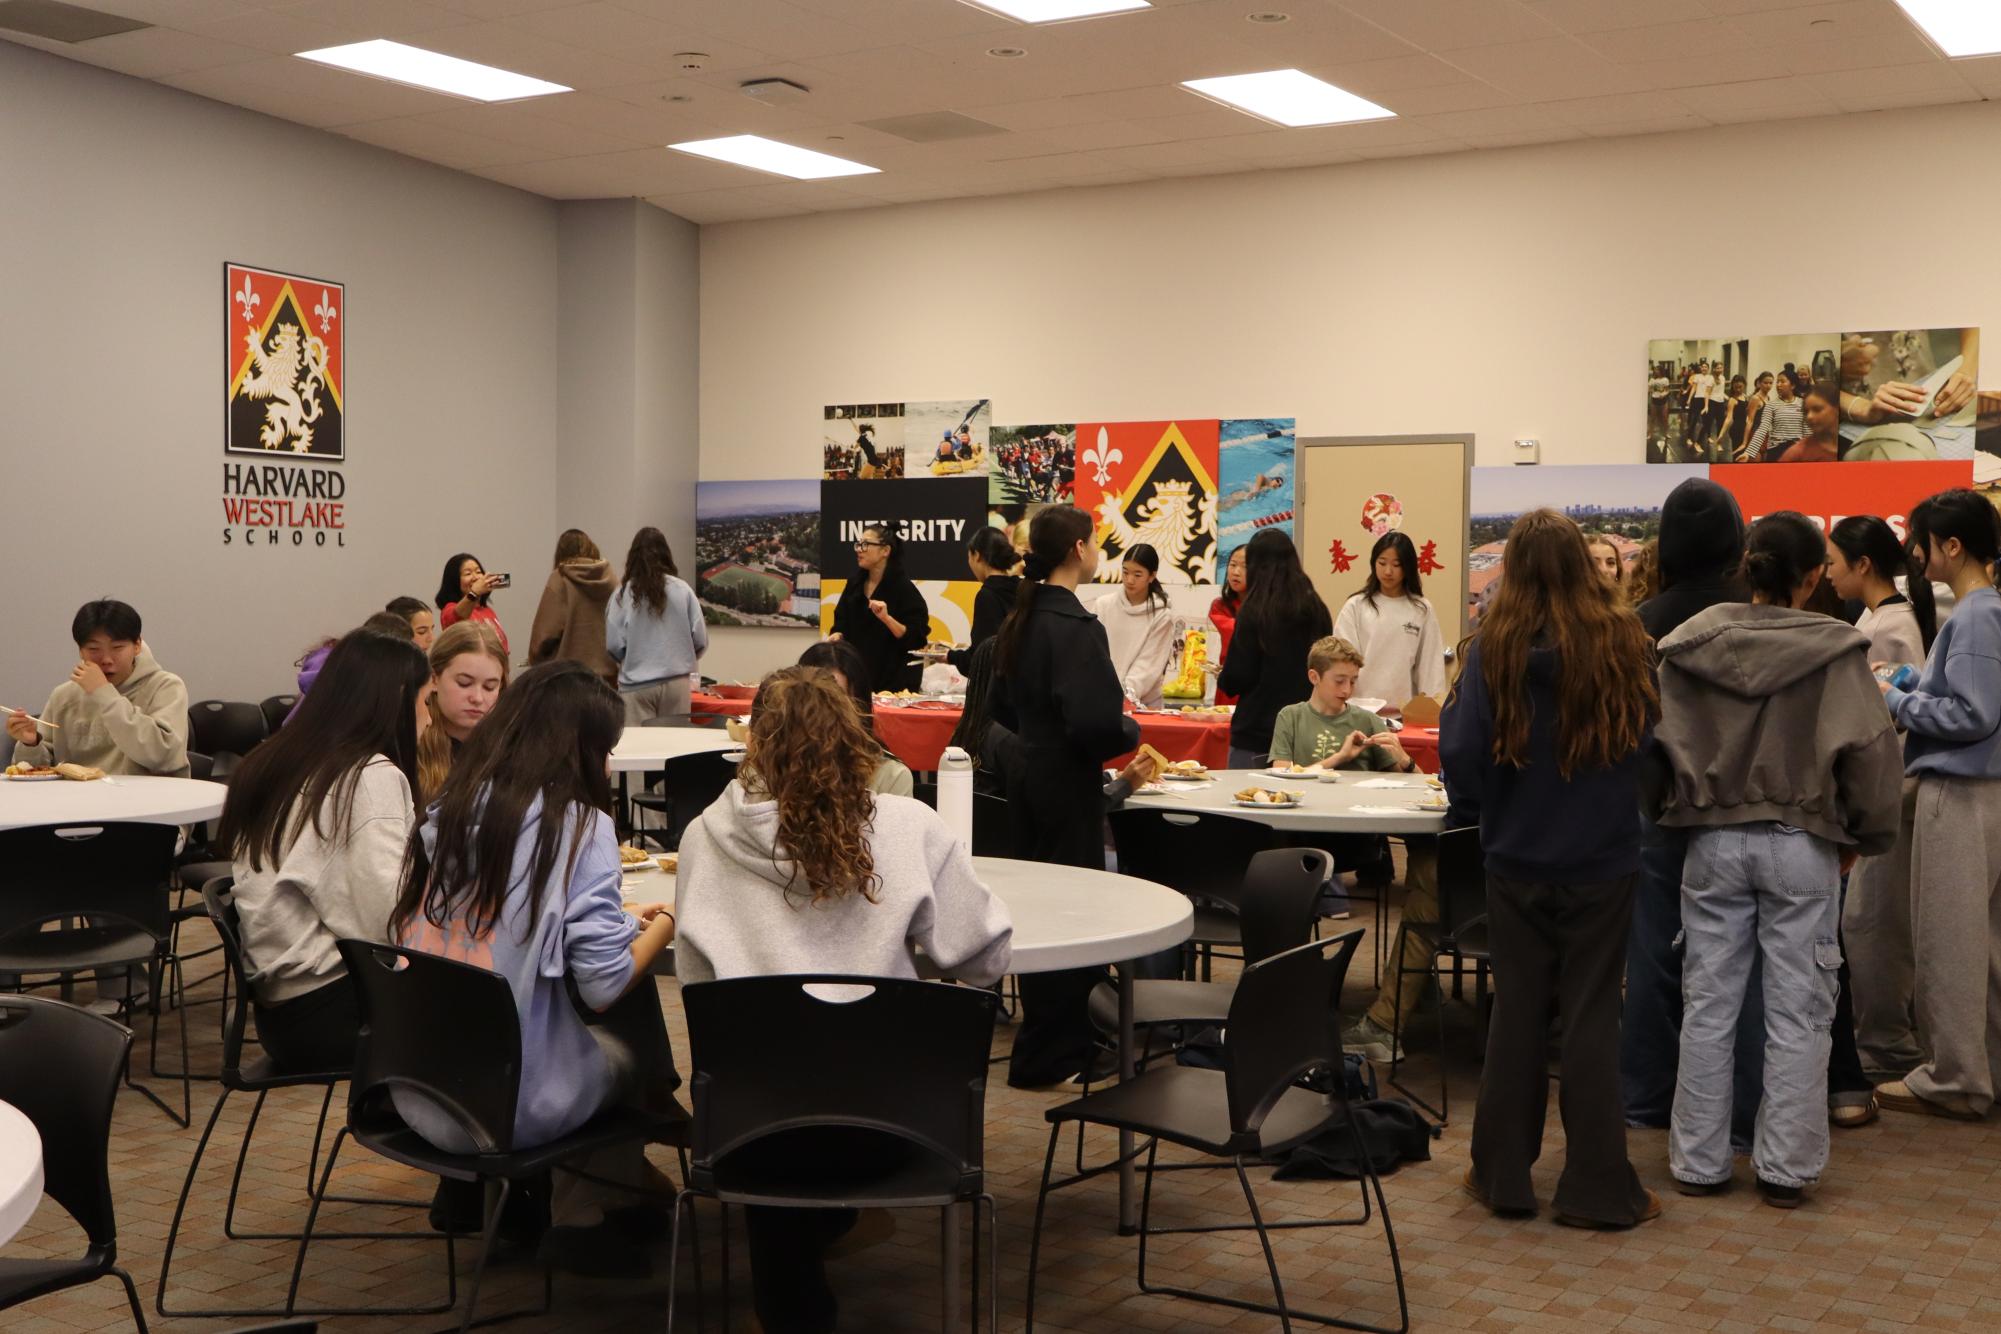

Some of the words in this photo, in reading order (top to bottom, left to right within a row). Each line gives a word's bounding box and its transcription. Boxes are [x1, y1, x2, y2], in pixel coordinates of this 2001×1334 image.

[224, 463, 345, 499] HARVARD
[223, 498, 345, 528] WESTLAKE
[223, 528, 345, 546] SCHOOL
[840, 519, 966, 542] INGRITY
